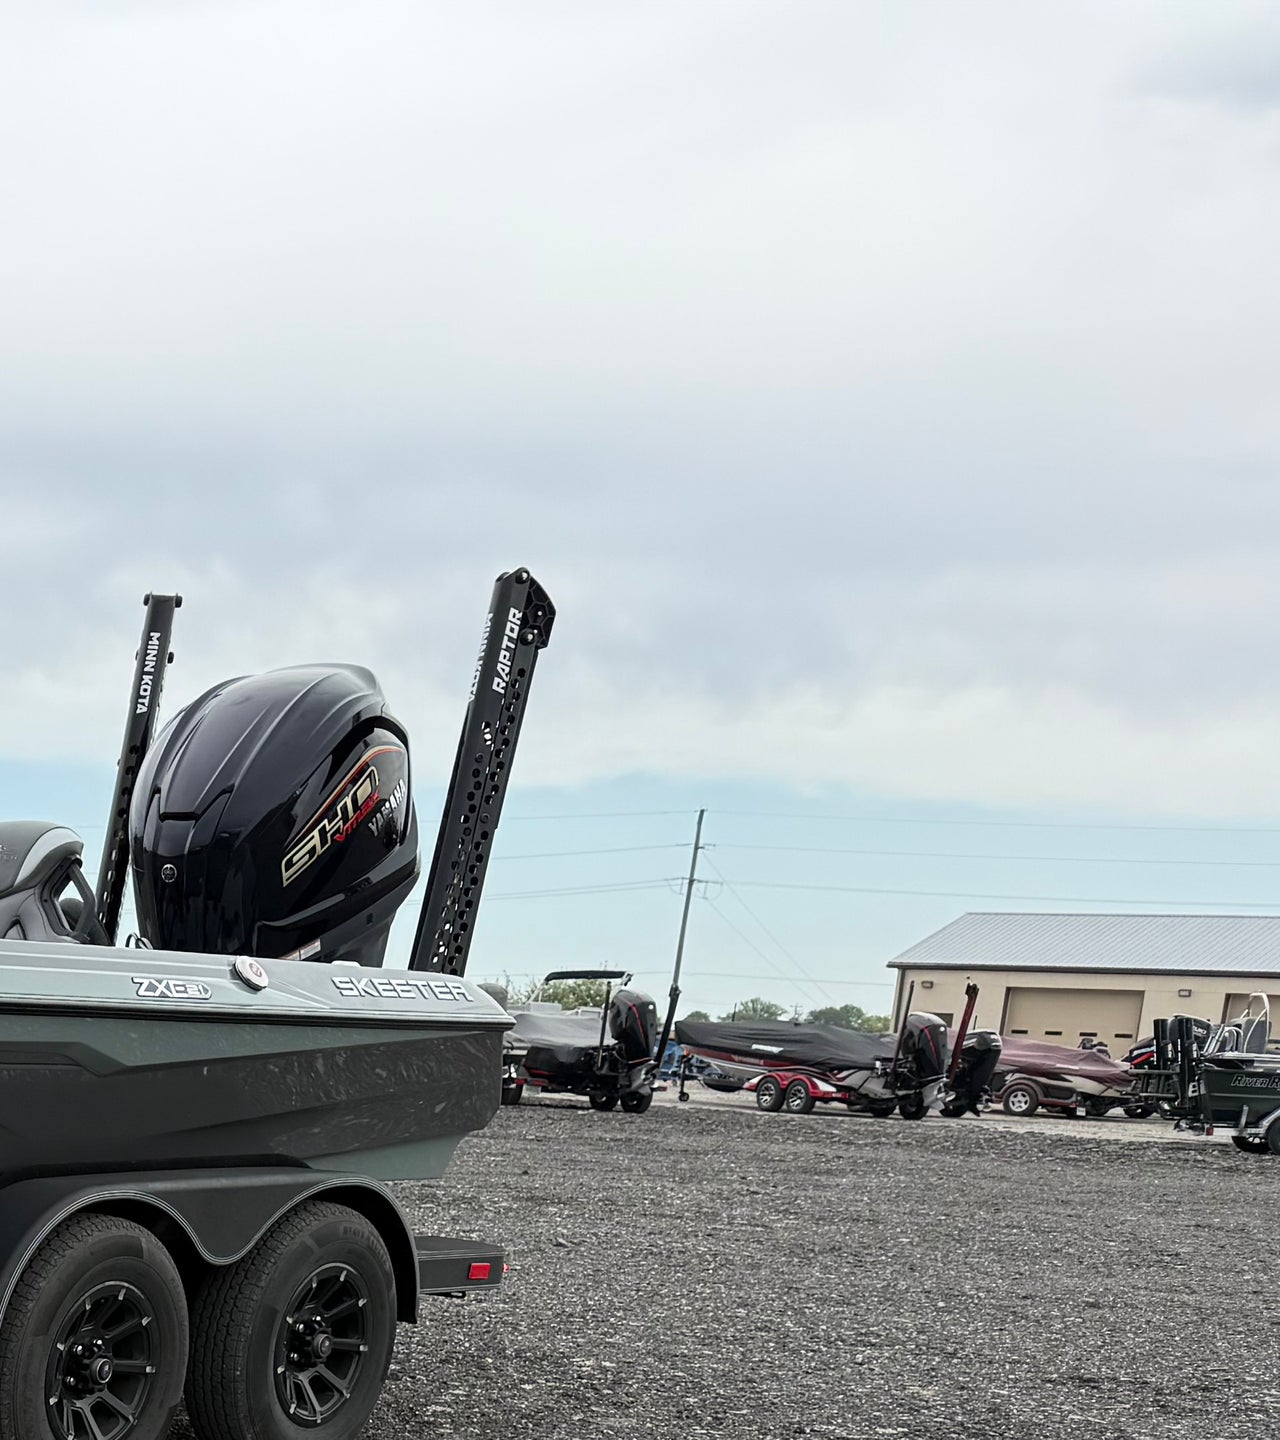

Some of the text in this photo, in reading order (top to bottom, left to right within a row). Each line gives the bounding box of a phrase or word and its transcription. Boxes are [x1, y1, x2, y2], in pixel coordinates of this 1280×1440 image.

[135, 631, 161, 714] MINN KOTA
[491, 607, 523, 694] RAPTOR
[281, 766, 379, 887] SHO
[368, 778, 407, 837] YAMAHA
[331, 976, 474, 1003] SKEETER
